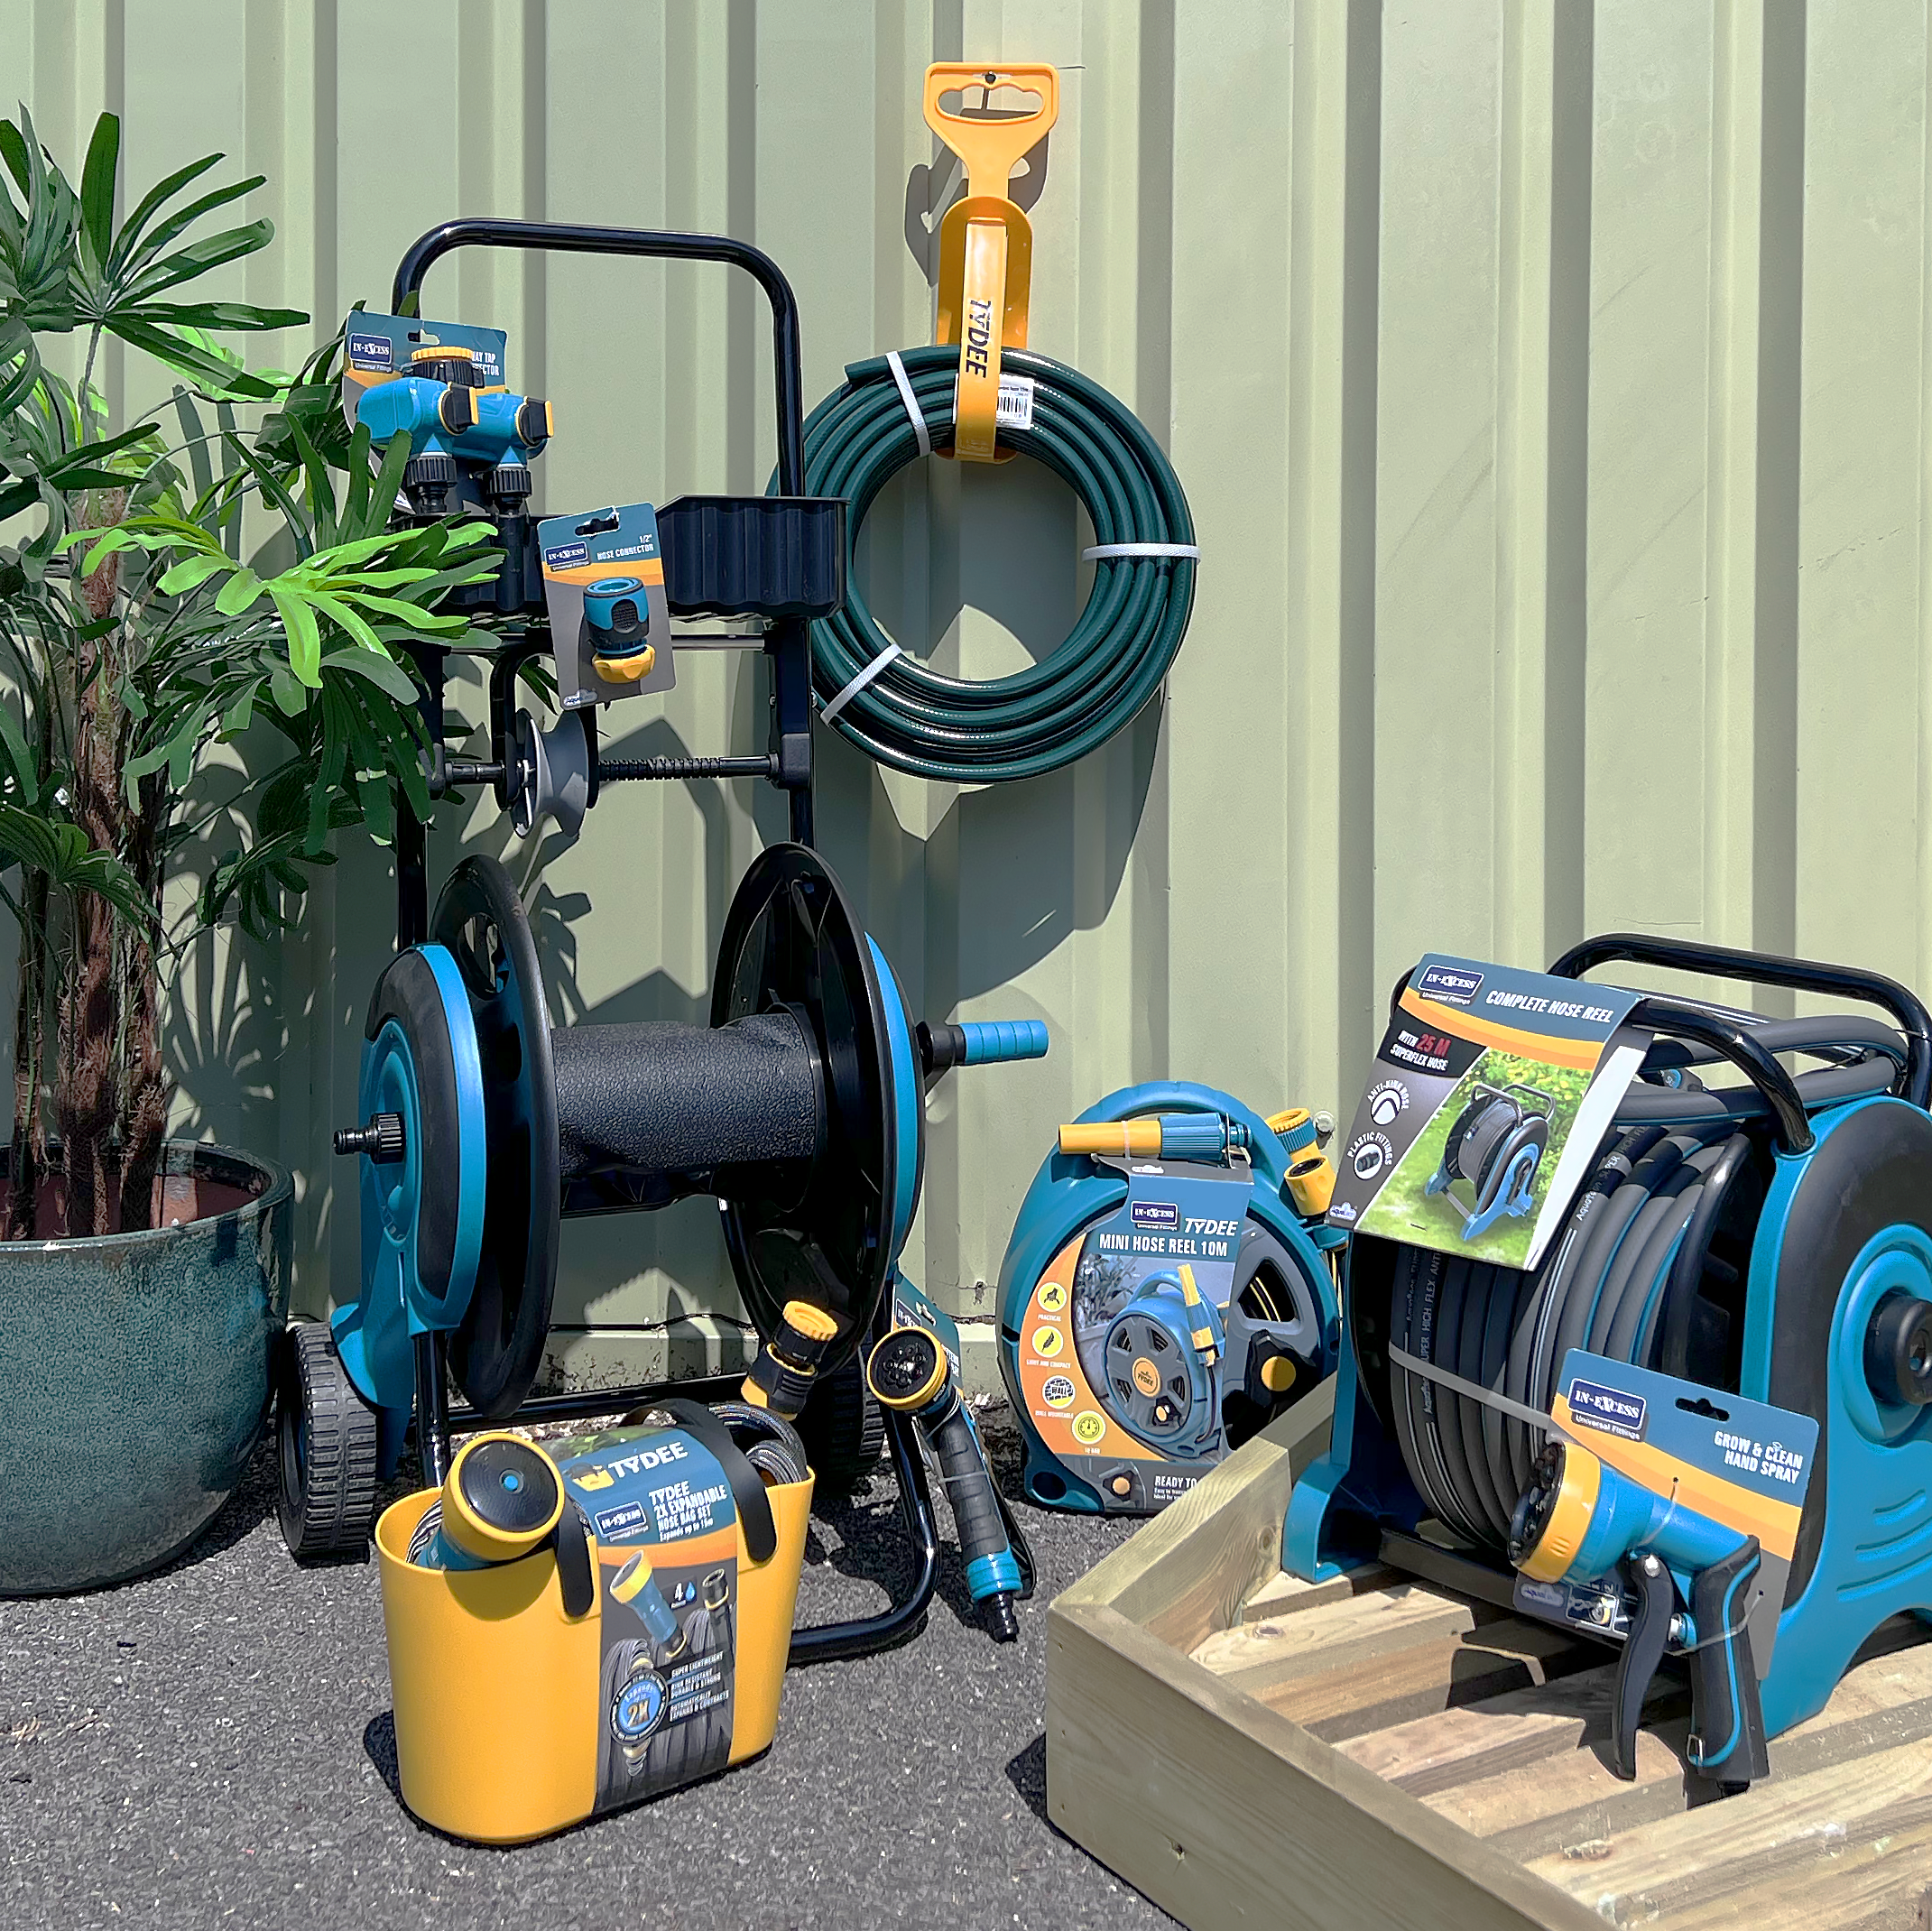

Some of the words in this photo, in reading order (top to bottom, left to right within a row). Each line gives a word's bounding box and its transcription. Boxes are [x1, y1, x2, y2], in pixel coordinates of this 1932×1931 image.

[353, 342, 390, 356] IN-EXCESS
[966, 300, 992, 378] TYDEE
[485, 352, 496, 364] TAP
[596, 550, 615, 560] HOSE
[615, 543, 654, 558] CONNECTOR
[1426, 973, 1477, 990] IN-EXCESS
[1485, 990, 1548, 1013] COMPLETE
[1548, 1001, 1584, 1019] HOSE
[1584, 1006, 1614, 1023] REEL
[1390, 1043, 1427, 1066] SUPERFLEX
[1427, 1056, 1448, 1071] HOSE
[1398, 1030, 1419, 1047] WITH
[1417, 1033, 1436, 1052] 25
[1434, 1037, 1452, 1058] M
[1400, 1086, 1410, 1110] HOSE
[1347, 1131, 1375, 1158] PLASTIC
[1375, 1132, 1392, 1166] FITTINGS
[1184, 1217, 1239, 1236] TYDEE
[1100, 1233, 1129, 1251] MINI
[1132, 1235, 1165, 1252] HOSE
[1169, 1238, 1197, 1255] REEL
[1201, 1241, 1228, 1257] 10M
[1425, 1280, 1437, 1303] FLEX
[1575, 1390, 1640, 1419] IN-EXCESS
[1575, 1414, 1611, 1433] Universal
[1612, 1425, 1641, 1441] Fittings
[608, 1442, 689, 1478] TYDEE
[1714, 1430, 1751, 1454] GROW
[1752, 1443, 1762, 1456] &
[1764, 1445, 1803, 1470] CLEAN
[1724, 1450, 1759, 1474] HAND
[1760, 1461, 1800, 1484] SPRAY
[648, 1481, 690, 1505] TYDEE
[1155, 1475, 1183, 1488] READY
[654, 1503, 669, 1520] 2X
[668, 1484, 727, 1515] EXPANDABLE
[658, 1514, 679, 1532] HOSE
[680, 1508, 696, 1525] BAG
[698, 1503, 711, 1520] SET
[674, 1583, 684, 1602] 4
